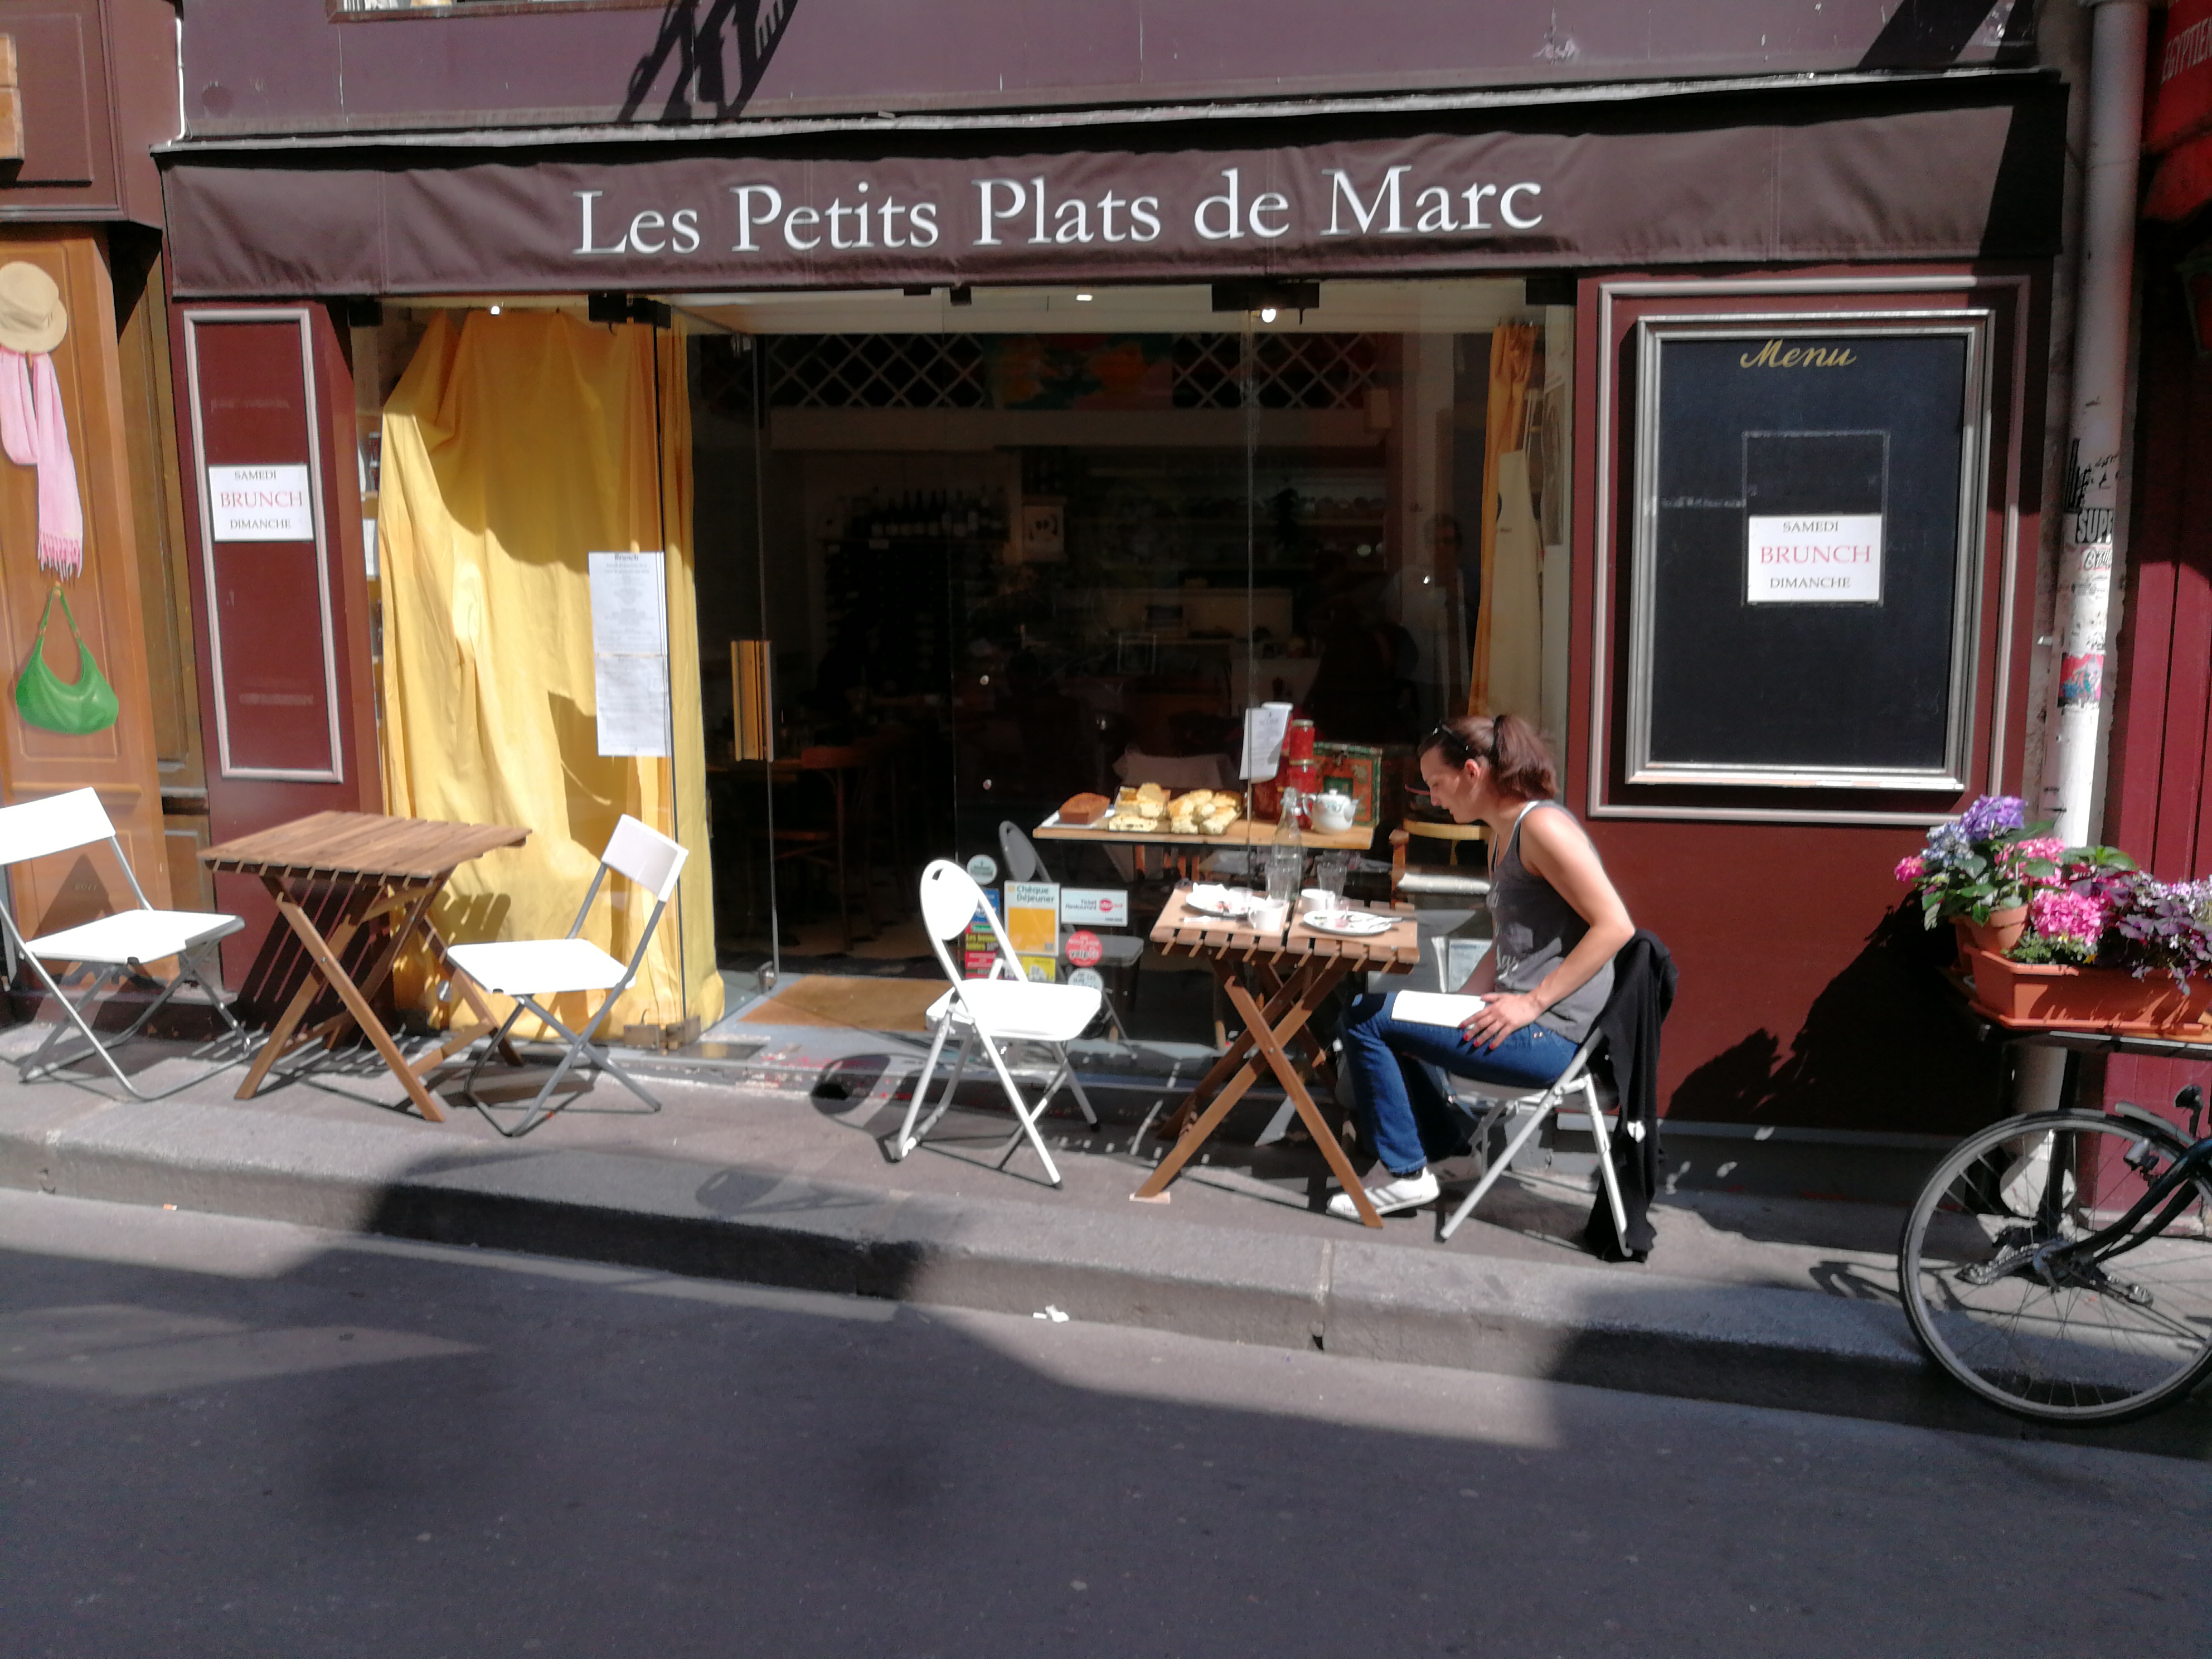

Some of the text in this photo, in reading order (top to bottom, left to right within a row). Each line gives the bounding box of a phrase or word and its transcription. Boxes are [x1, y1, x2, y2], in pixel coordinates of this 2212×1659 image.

[573, 165, 1542, 254] Les Petits Plats de Marc
[1740, 338, 1857, 368] Menu
[234, 470, 278, 481] SAMEDI
[220, 490, 303, 508] BRUNCH
[230, 519, 292, 530] DIMANCHE
[1783, 521, 1839, 533] SAMEDI
[1760, 545, 1871, 564] BRUNCH
[1769, 576, 1851, 589] DIMANCHE
